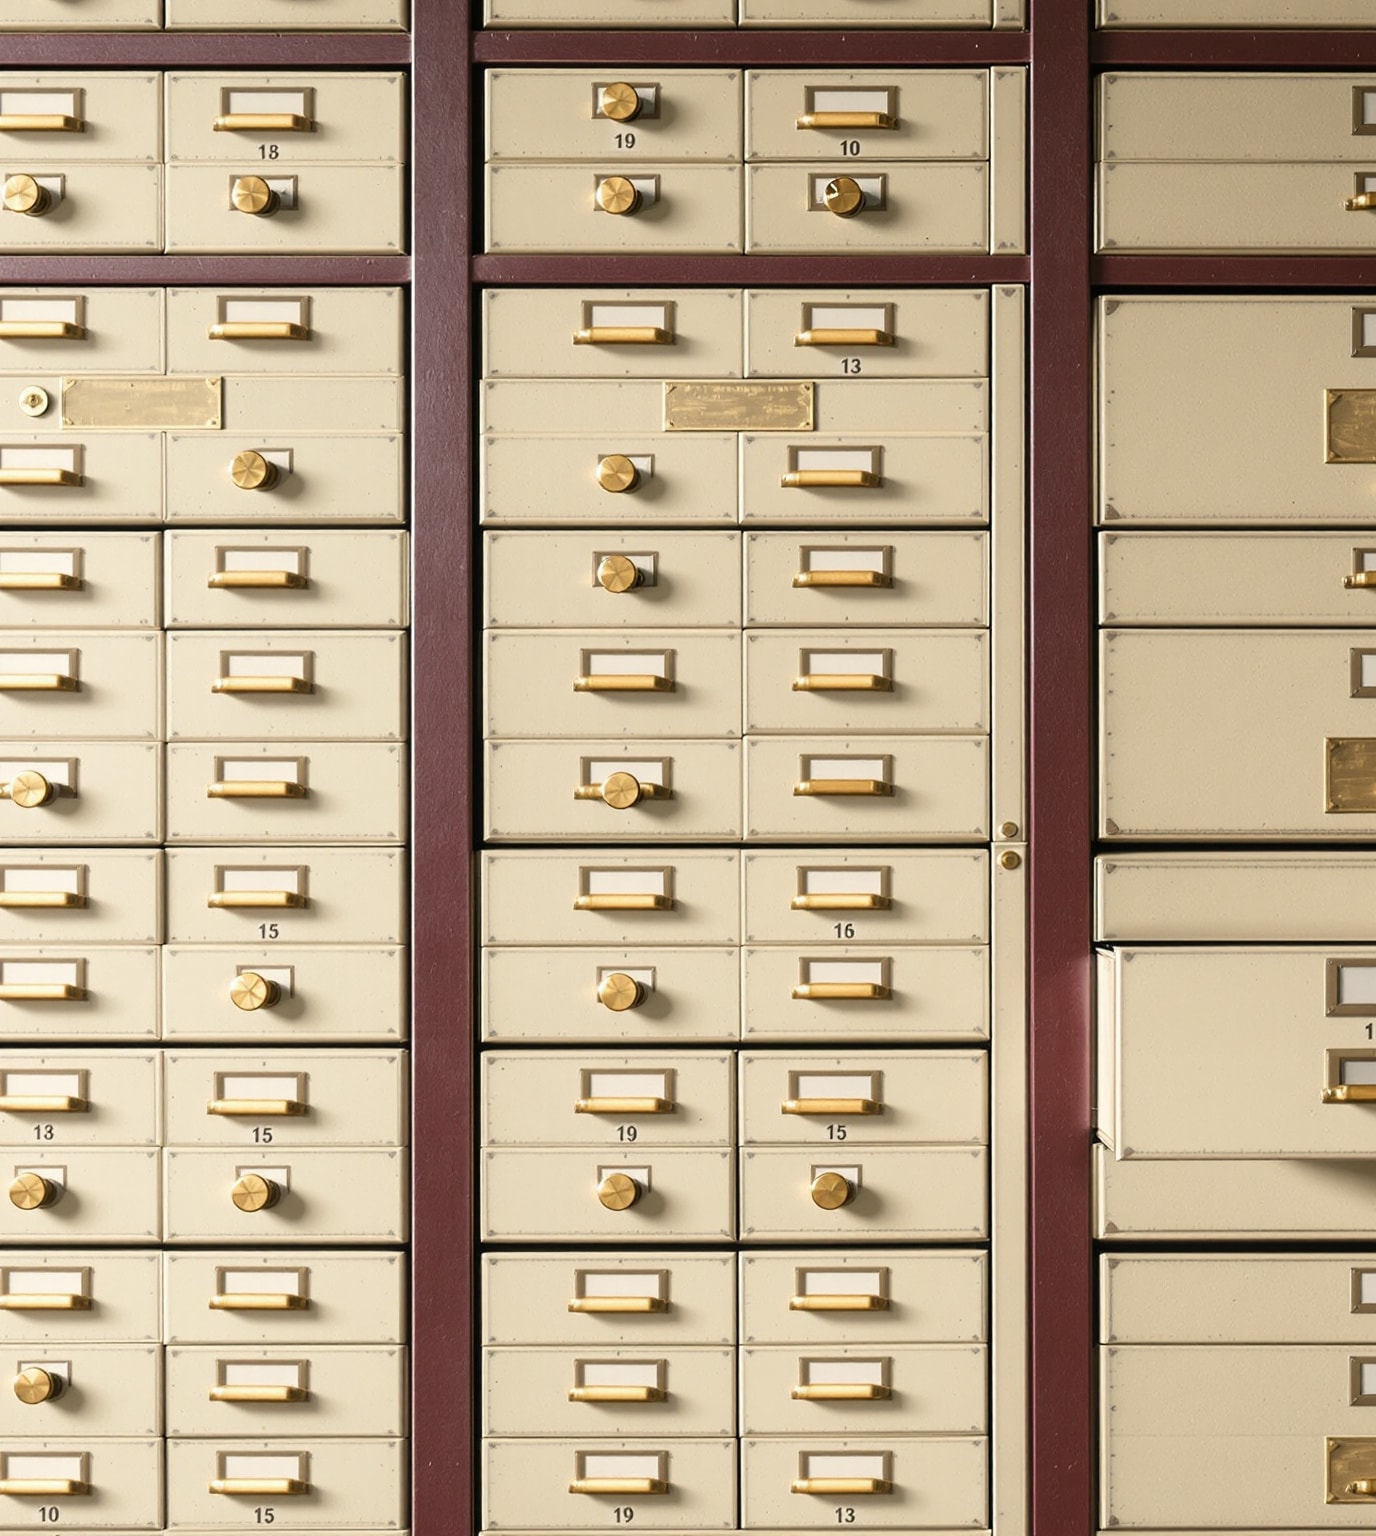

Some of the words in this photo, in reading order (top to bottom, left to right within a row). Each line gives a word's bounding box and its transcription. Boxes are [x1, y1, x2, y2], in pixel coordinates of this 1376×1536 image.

[615, 133, 635, 149] 19
[840, 139, 860, 156] 10
[841, 357, 861, 374] 13
[258, 923, 279, 939] 15
[833, 922, 854, 938] 16
[252, 1127, 273, 1143] 15
[617, 1125, 637, 1142] 19
[827, 1124, 847, 1140] 15
[38, 1505, 59, 1522] 10
[254, 1506, 274, 1524] 15
[613, 1506, 633, 1523] 19
[835, 1506, 855, 1523] 13
